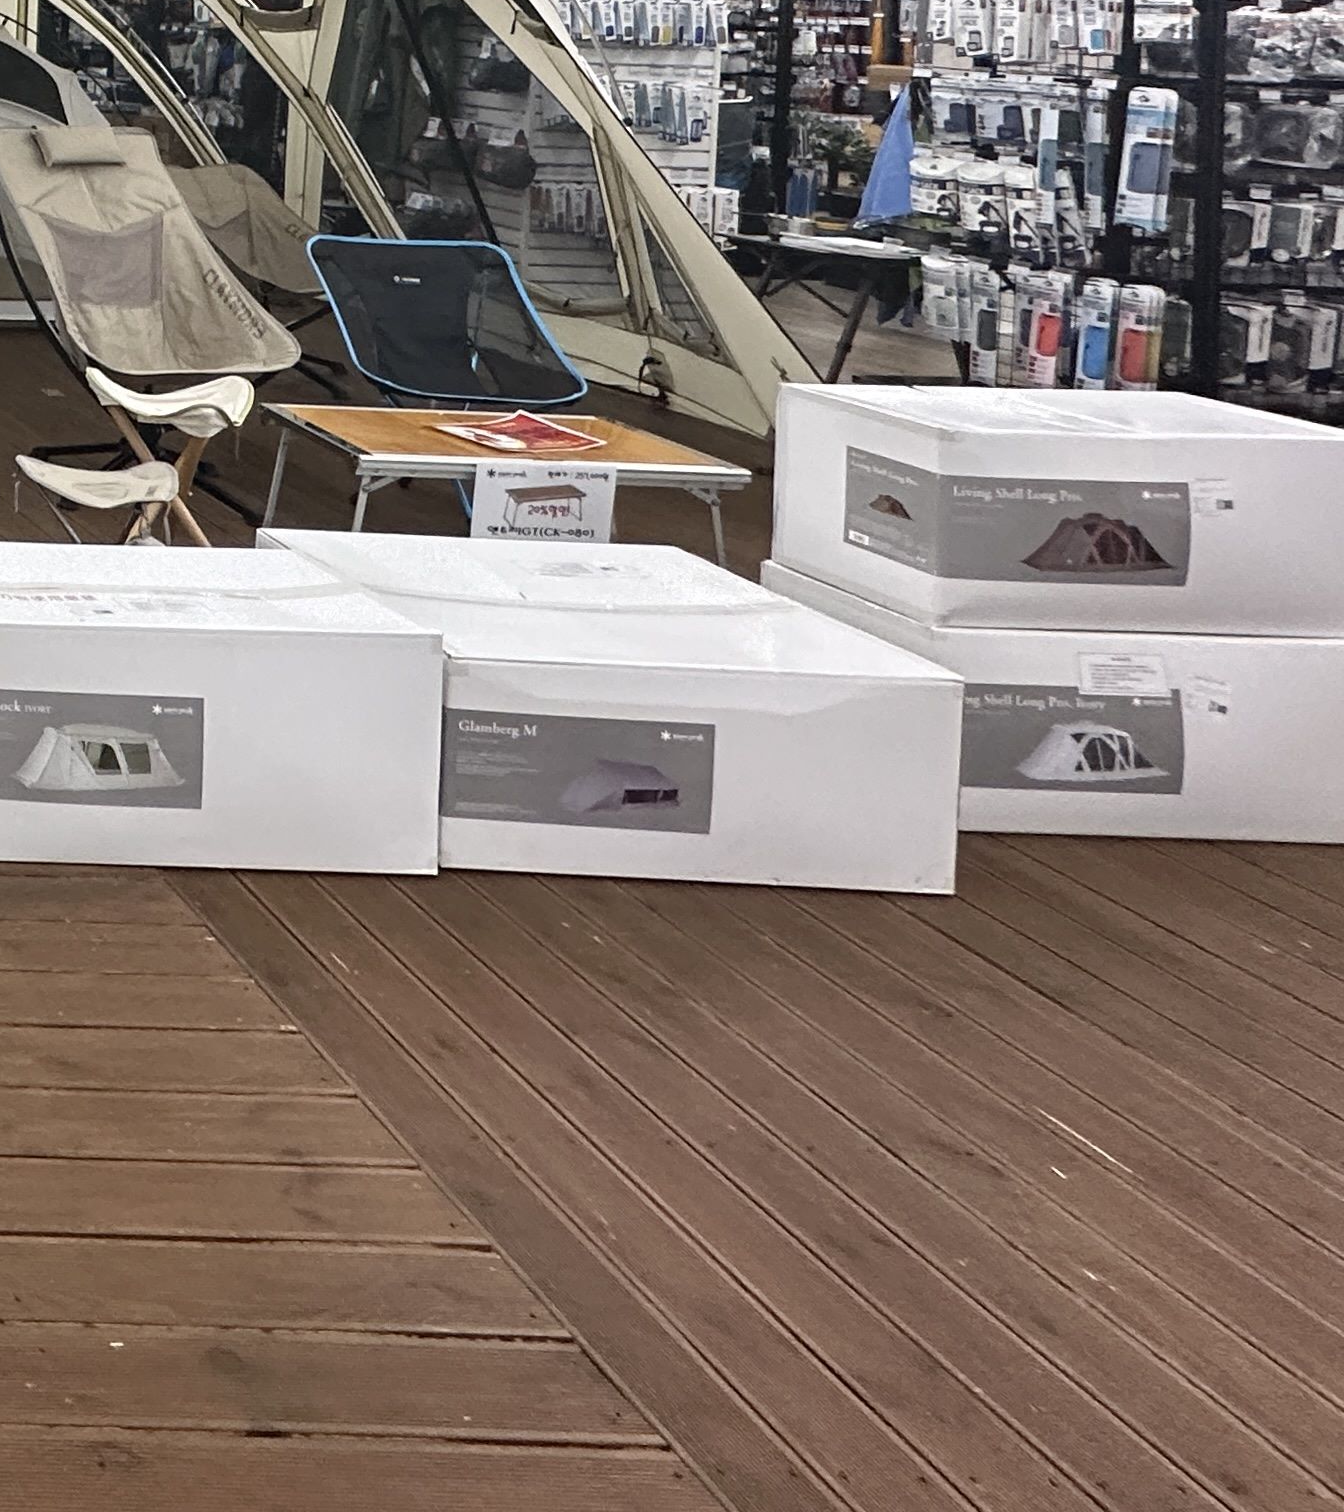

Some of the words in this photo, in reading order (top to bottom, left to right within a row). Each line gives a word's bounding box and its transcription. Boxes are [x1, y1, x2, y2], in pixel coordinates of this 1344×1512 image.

[995, 487, 1025, 500] Shell
[1026, 488, 1058, 504] Long
[1015, 695, 1046, 711] Long
[457, 719, 520, 739] Glamberg
[522, 724, 539, 737] M
